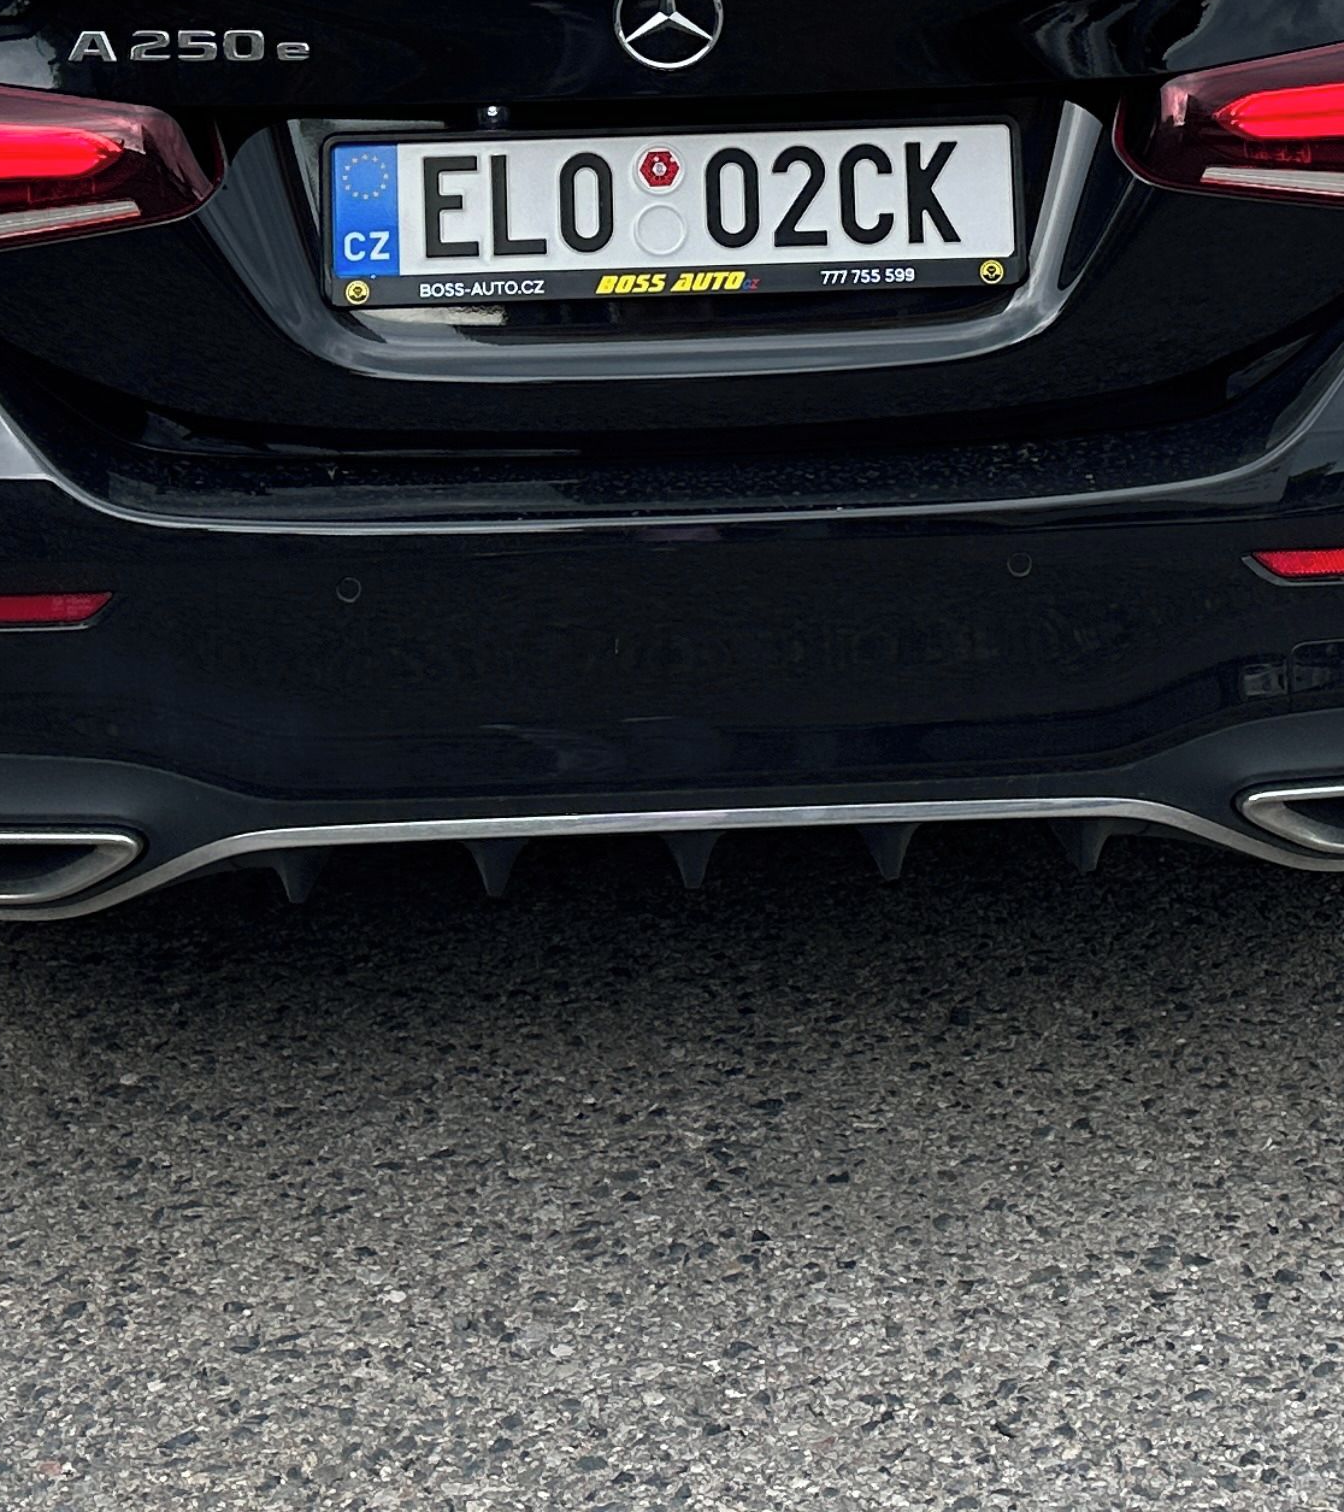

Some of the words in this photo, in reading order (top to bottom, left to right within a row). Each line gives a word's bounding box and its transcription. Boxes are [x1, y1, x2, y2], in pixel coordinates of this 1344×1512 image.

[68, 30, 117, 61] A
[130, 29, 264, 61] 250
[344, 231, 390, 261] CZ
[596, 274, 665, 295] BOSS
[821, 270, 848, 285] 777
[853, 269, 881, 284] 755
[885, 268, 915, 283] 599
[419, 279, 545, 298] BOSS-AUTO.CZ
